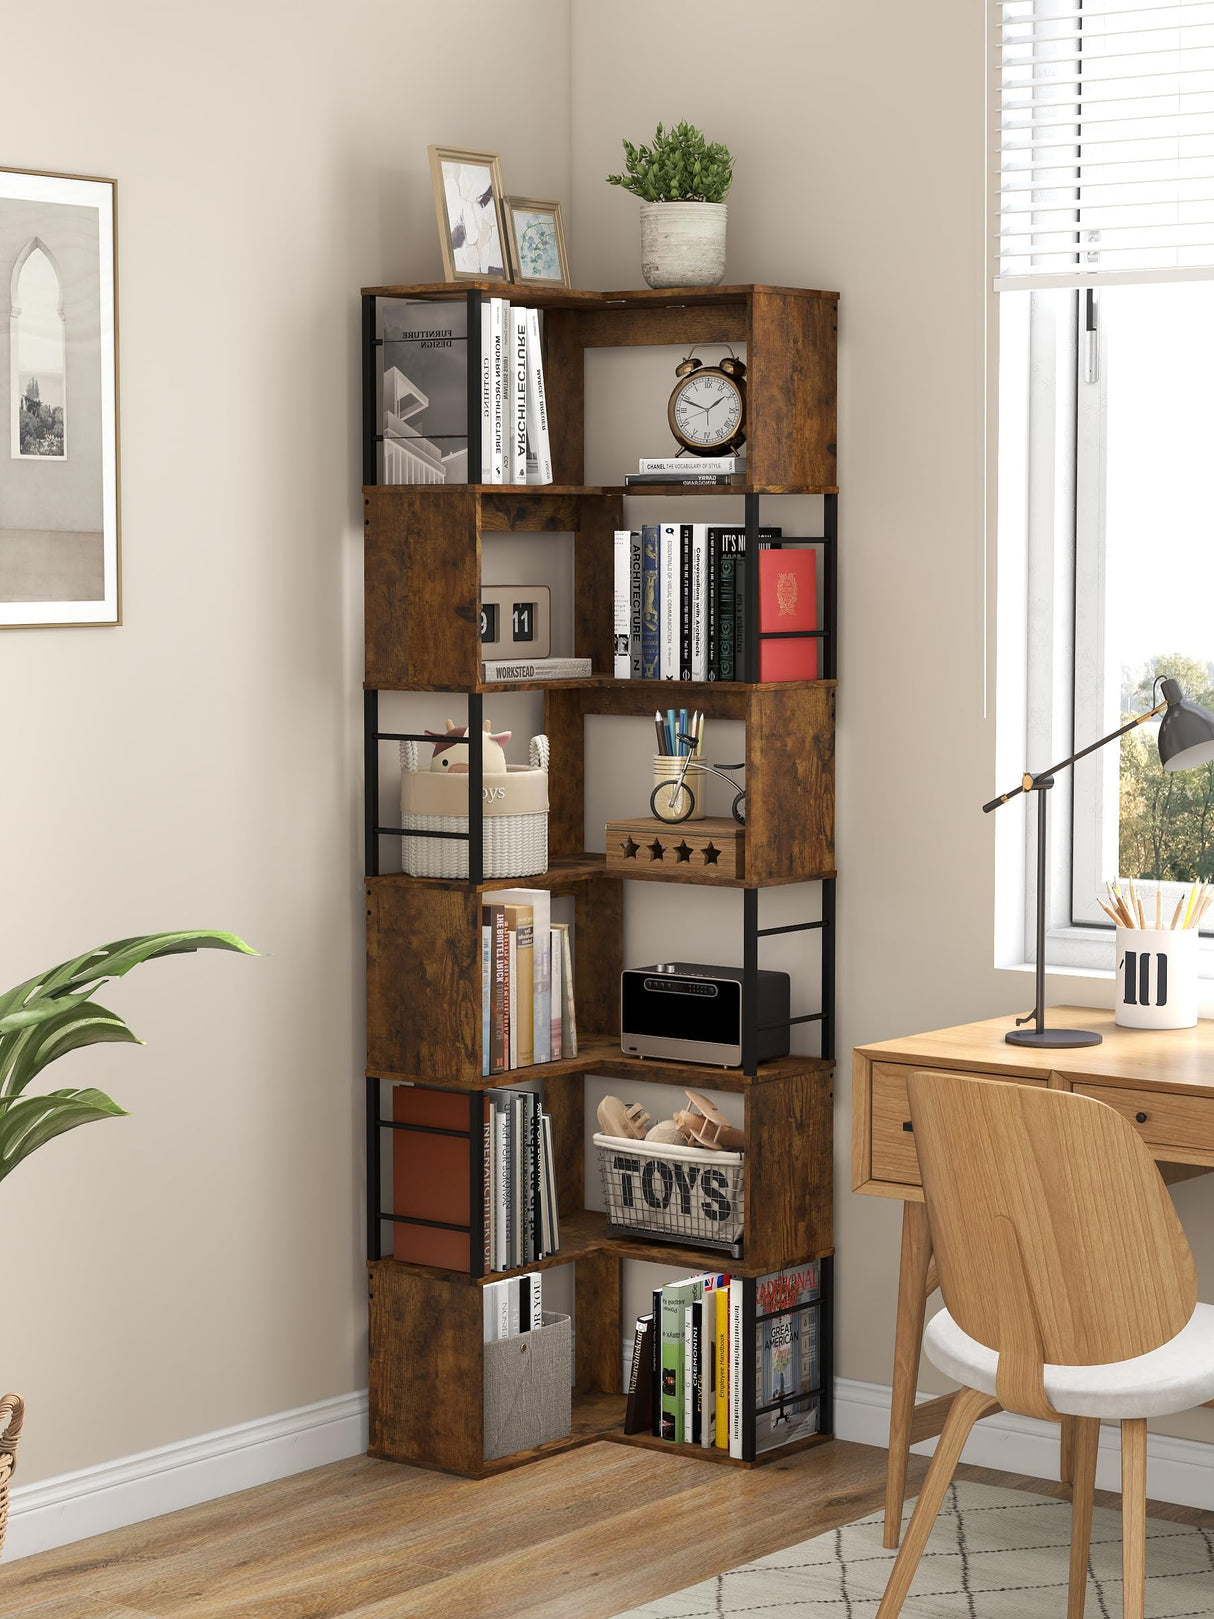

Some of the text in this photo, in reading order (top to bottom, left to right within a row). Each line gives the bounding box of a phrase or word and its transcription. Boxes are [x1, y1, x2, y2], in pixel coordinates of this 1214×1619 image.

[722, 534, 736, 551] IT'S
[513, 611, 528, 633] 11
[496, 666, 534, 679] WORKSTEAD
[482, 787, 505, 803] oys
[614, 1156, 731, 1221] TOYS
[756, 1268, 818, 1304] ADITIONAL
[771, 1322, 792, 1338] GREAT
[765, 1331, 799, 1350] AMERICAN
[629, 1330, 643, 1394] Weltarchitektur
